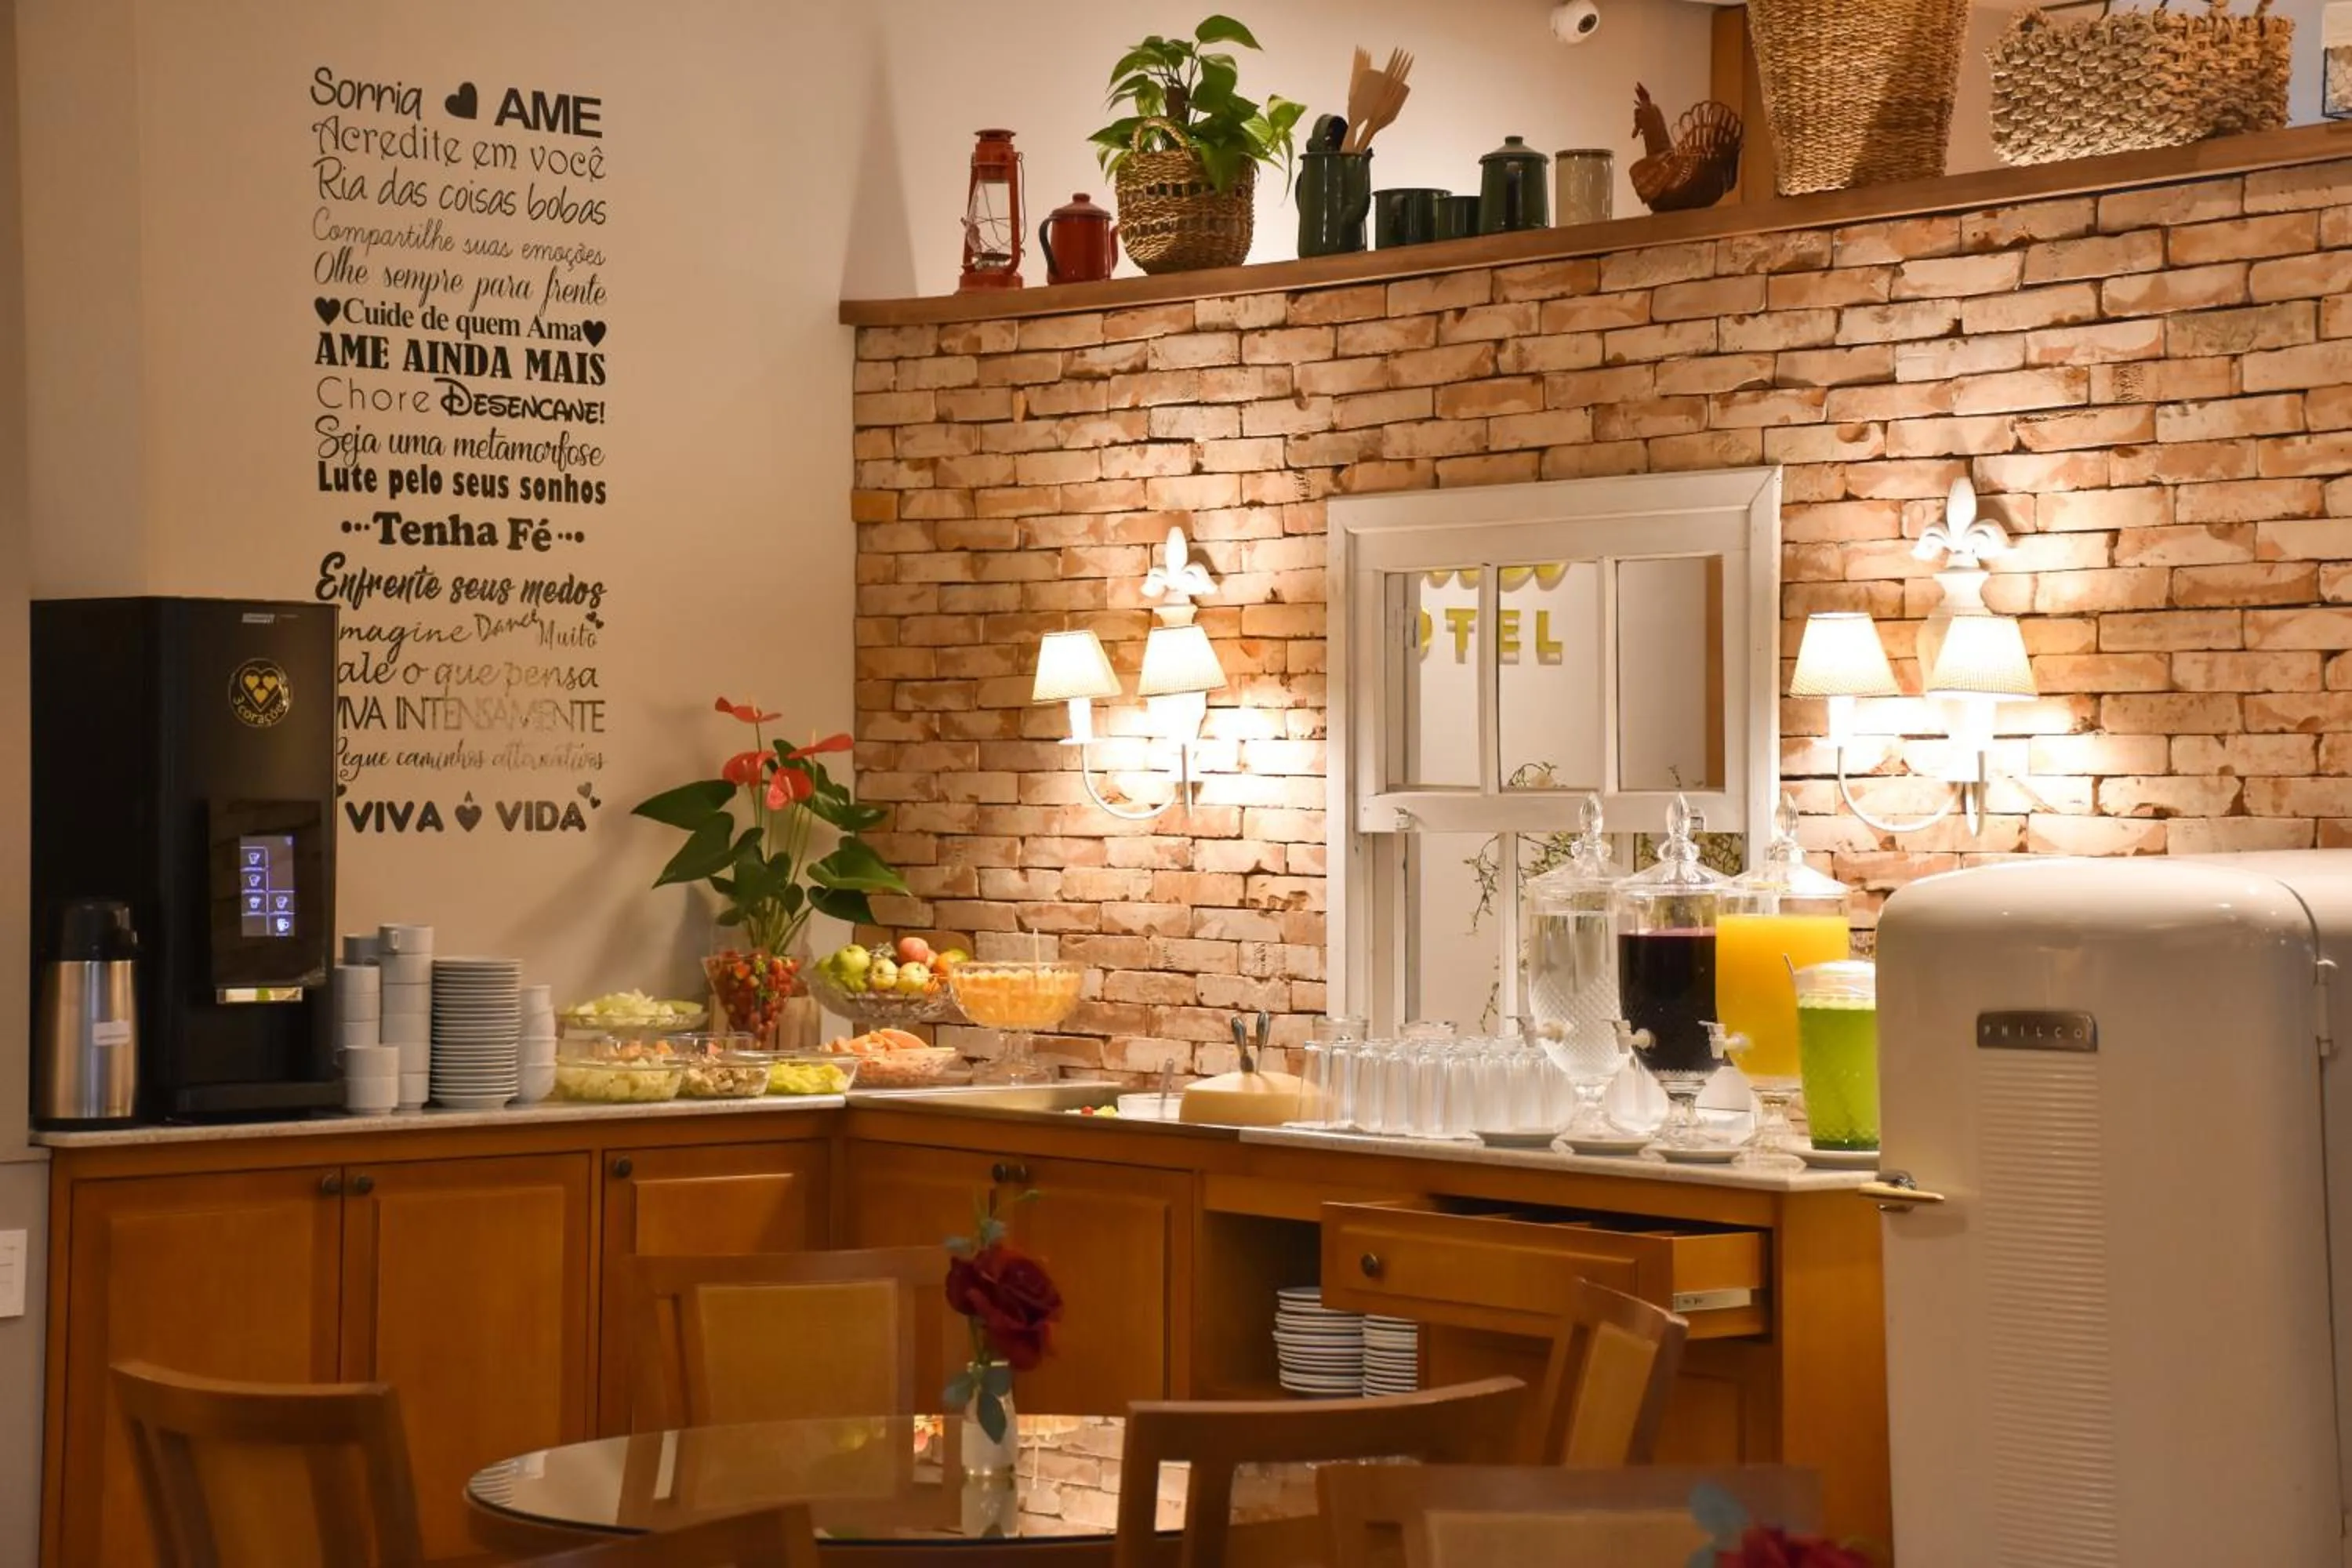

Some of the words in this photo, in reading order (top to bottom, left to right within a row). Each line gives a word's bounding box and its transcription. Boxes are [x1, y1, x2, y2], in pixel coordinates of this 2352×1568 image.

[310, 67, 423, 121] Sorria
[494, 87, 603, 138] AME
[311, 115, 463, 166] Acredite
[473, 141, 517, 170] em
[531, 145, 606, 182] você
[313, 157, 368, 201] Ria
[377, 167, 427, 207] das
[439, 180, 517, 215] coisas
[528, 183, 607, 226] bobas
[314, 206, 455, 256] Compartilhe
[462, 237, 514, 259] suas
[521, 242, 606, 272] emoções
[314, 246, 368, 285] Olhe
[383, 266, 464, 308] sempre
[470, 273, 534, 313] para
[539, 265, 607, 317] frente
[343, 298, 414, 328] Cuide
[421, 306, 449, 331] de
[456, 315, 520, 339] quem
[527, 314, 583, 342] Ama
[314, 332, 390, 370] AME
[402, 339, 512, 379] AINDA
[524, 347, 606, 387] MAIS
[317, 376, 430, 414] Chore
[314, 415, 382, 466] Seja
[389, 433, 446, 457] uma
[453, 426, 606, 472] metamorfose
[318, 460, 378, 494] Lute
[388, 464, 443, 499] pelo
[452, 470, 510, 499] seus
[520, 473, 606, 505] sonhos
[314, 551, 443, 611] Enfrente
[448, 574, 516, 604] seus
[520, 573, 608, 609] medos
[338, 622, 472, 664] magine
[337, 651, 397, 685] ale
[403, 662, 428, 684] o
[434, 662, 501, 699] que
[504, 661, 600, 698] pensa
[344, 800, 445, 833] VIVA
[495, 800, 587, 833] VIDA
[1984, 1024, 2083, 1039] PHILCO
